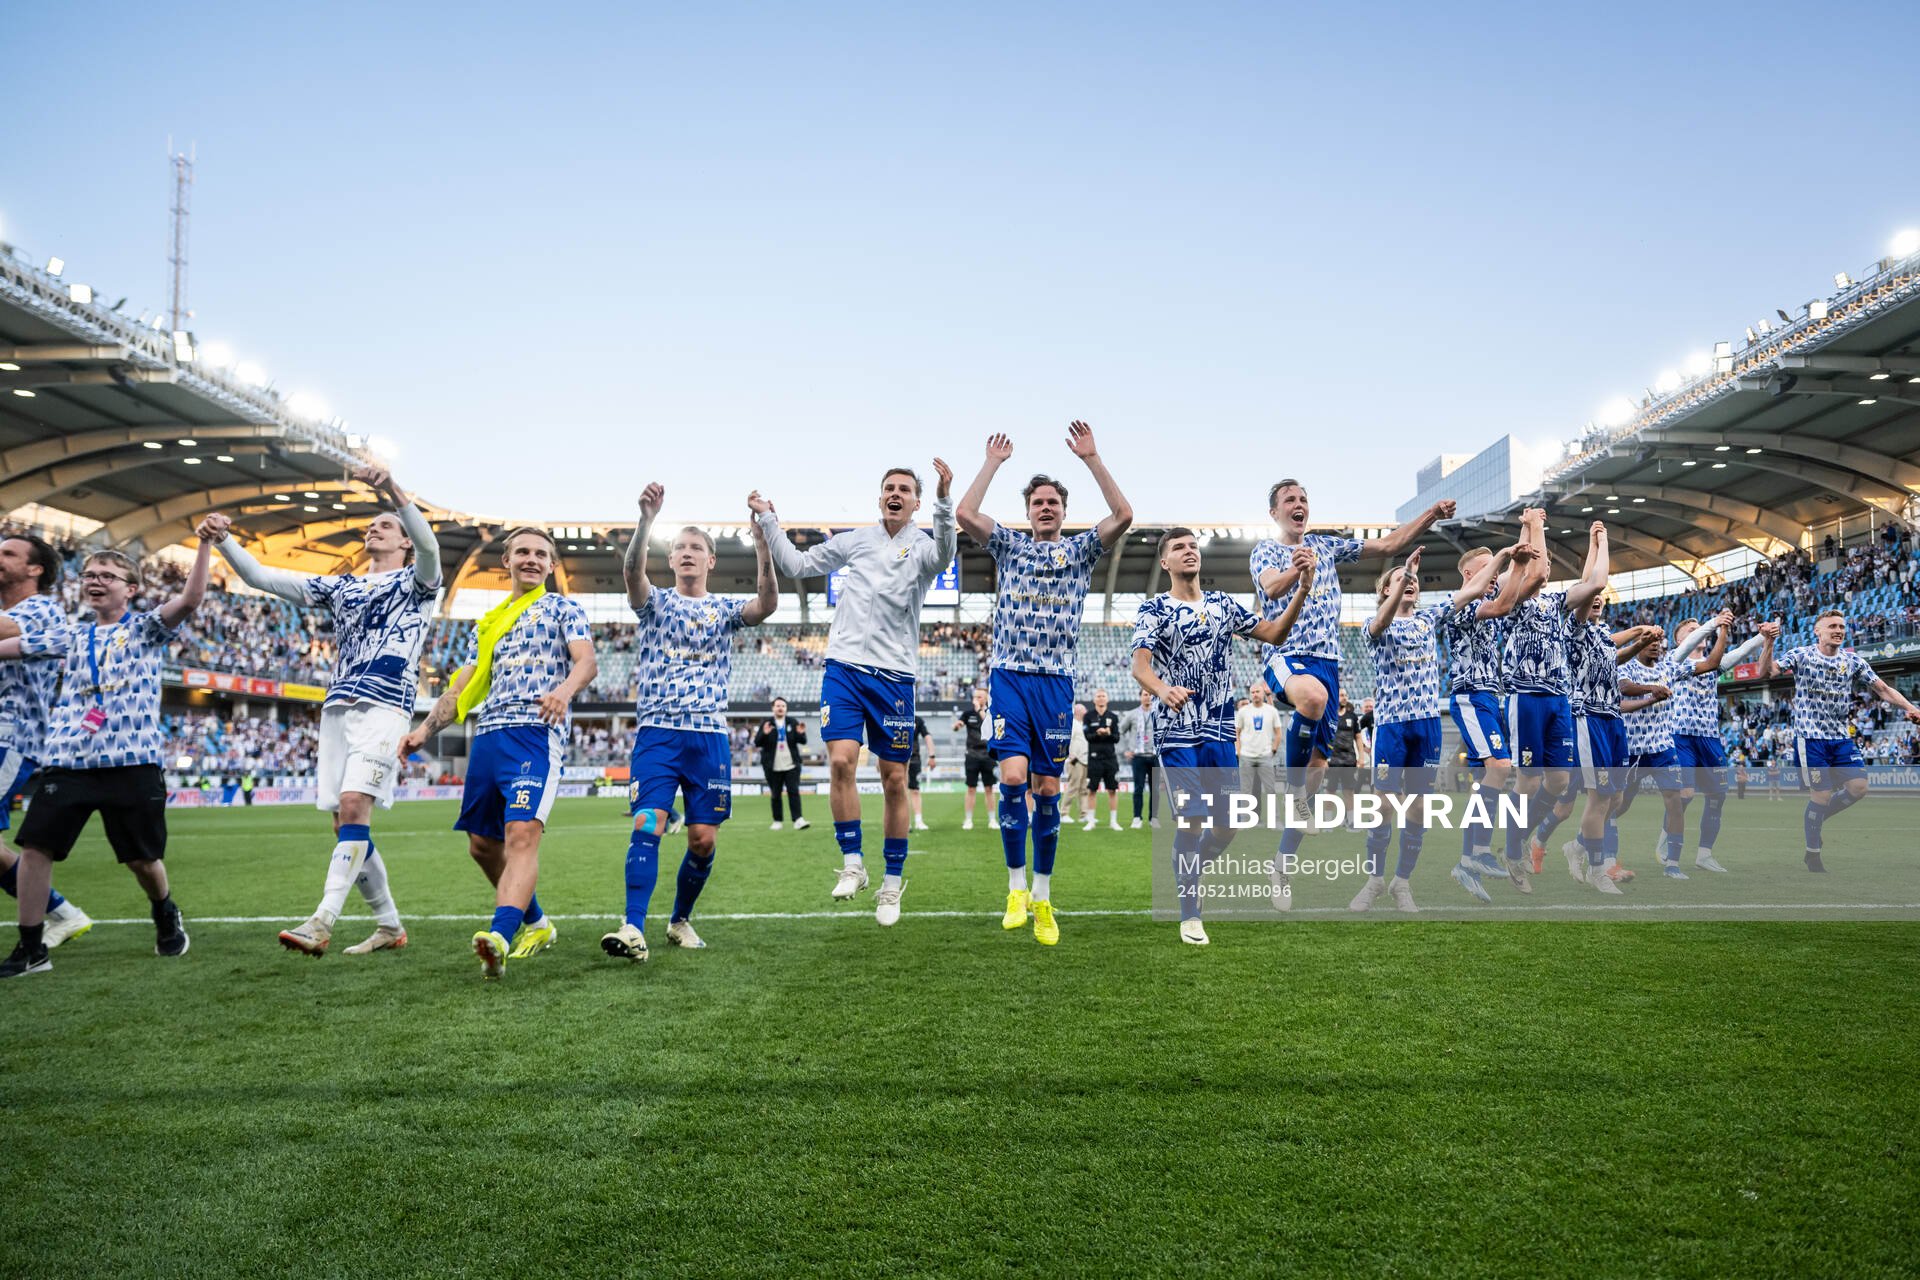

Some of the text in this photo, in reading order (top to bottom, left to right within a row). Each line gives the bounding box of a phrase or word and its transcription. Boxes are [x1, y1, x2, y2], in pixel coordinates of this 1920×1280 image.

[892, 730, 909, 745] 28
[371, 769, 384, 785] 12
[255, 789, 304, 802] INTERSPORT
[515, 789, 531, 805] 16
